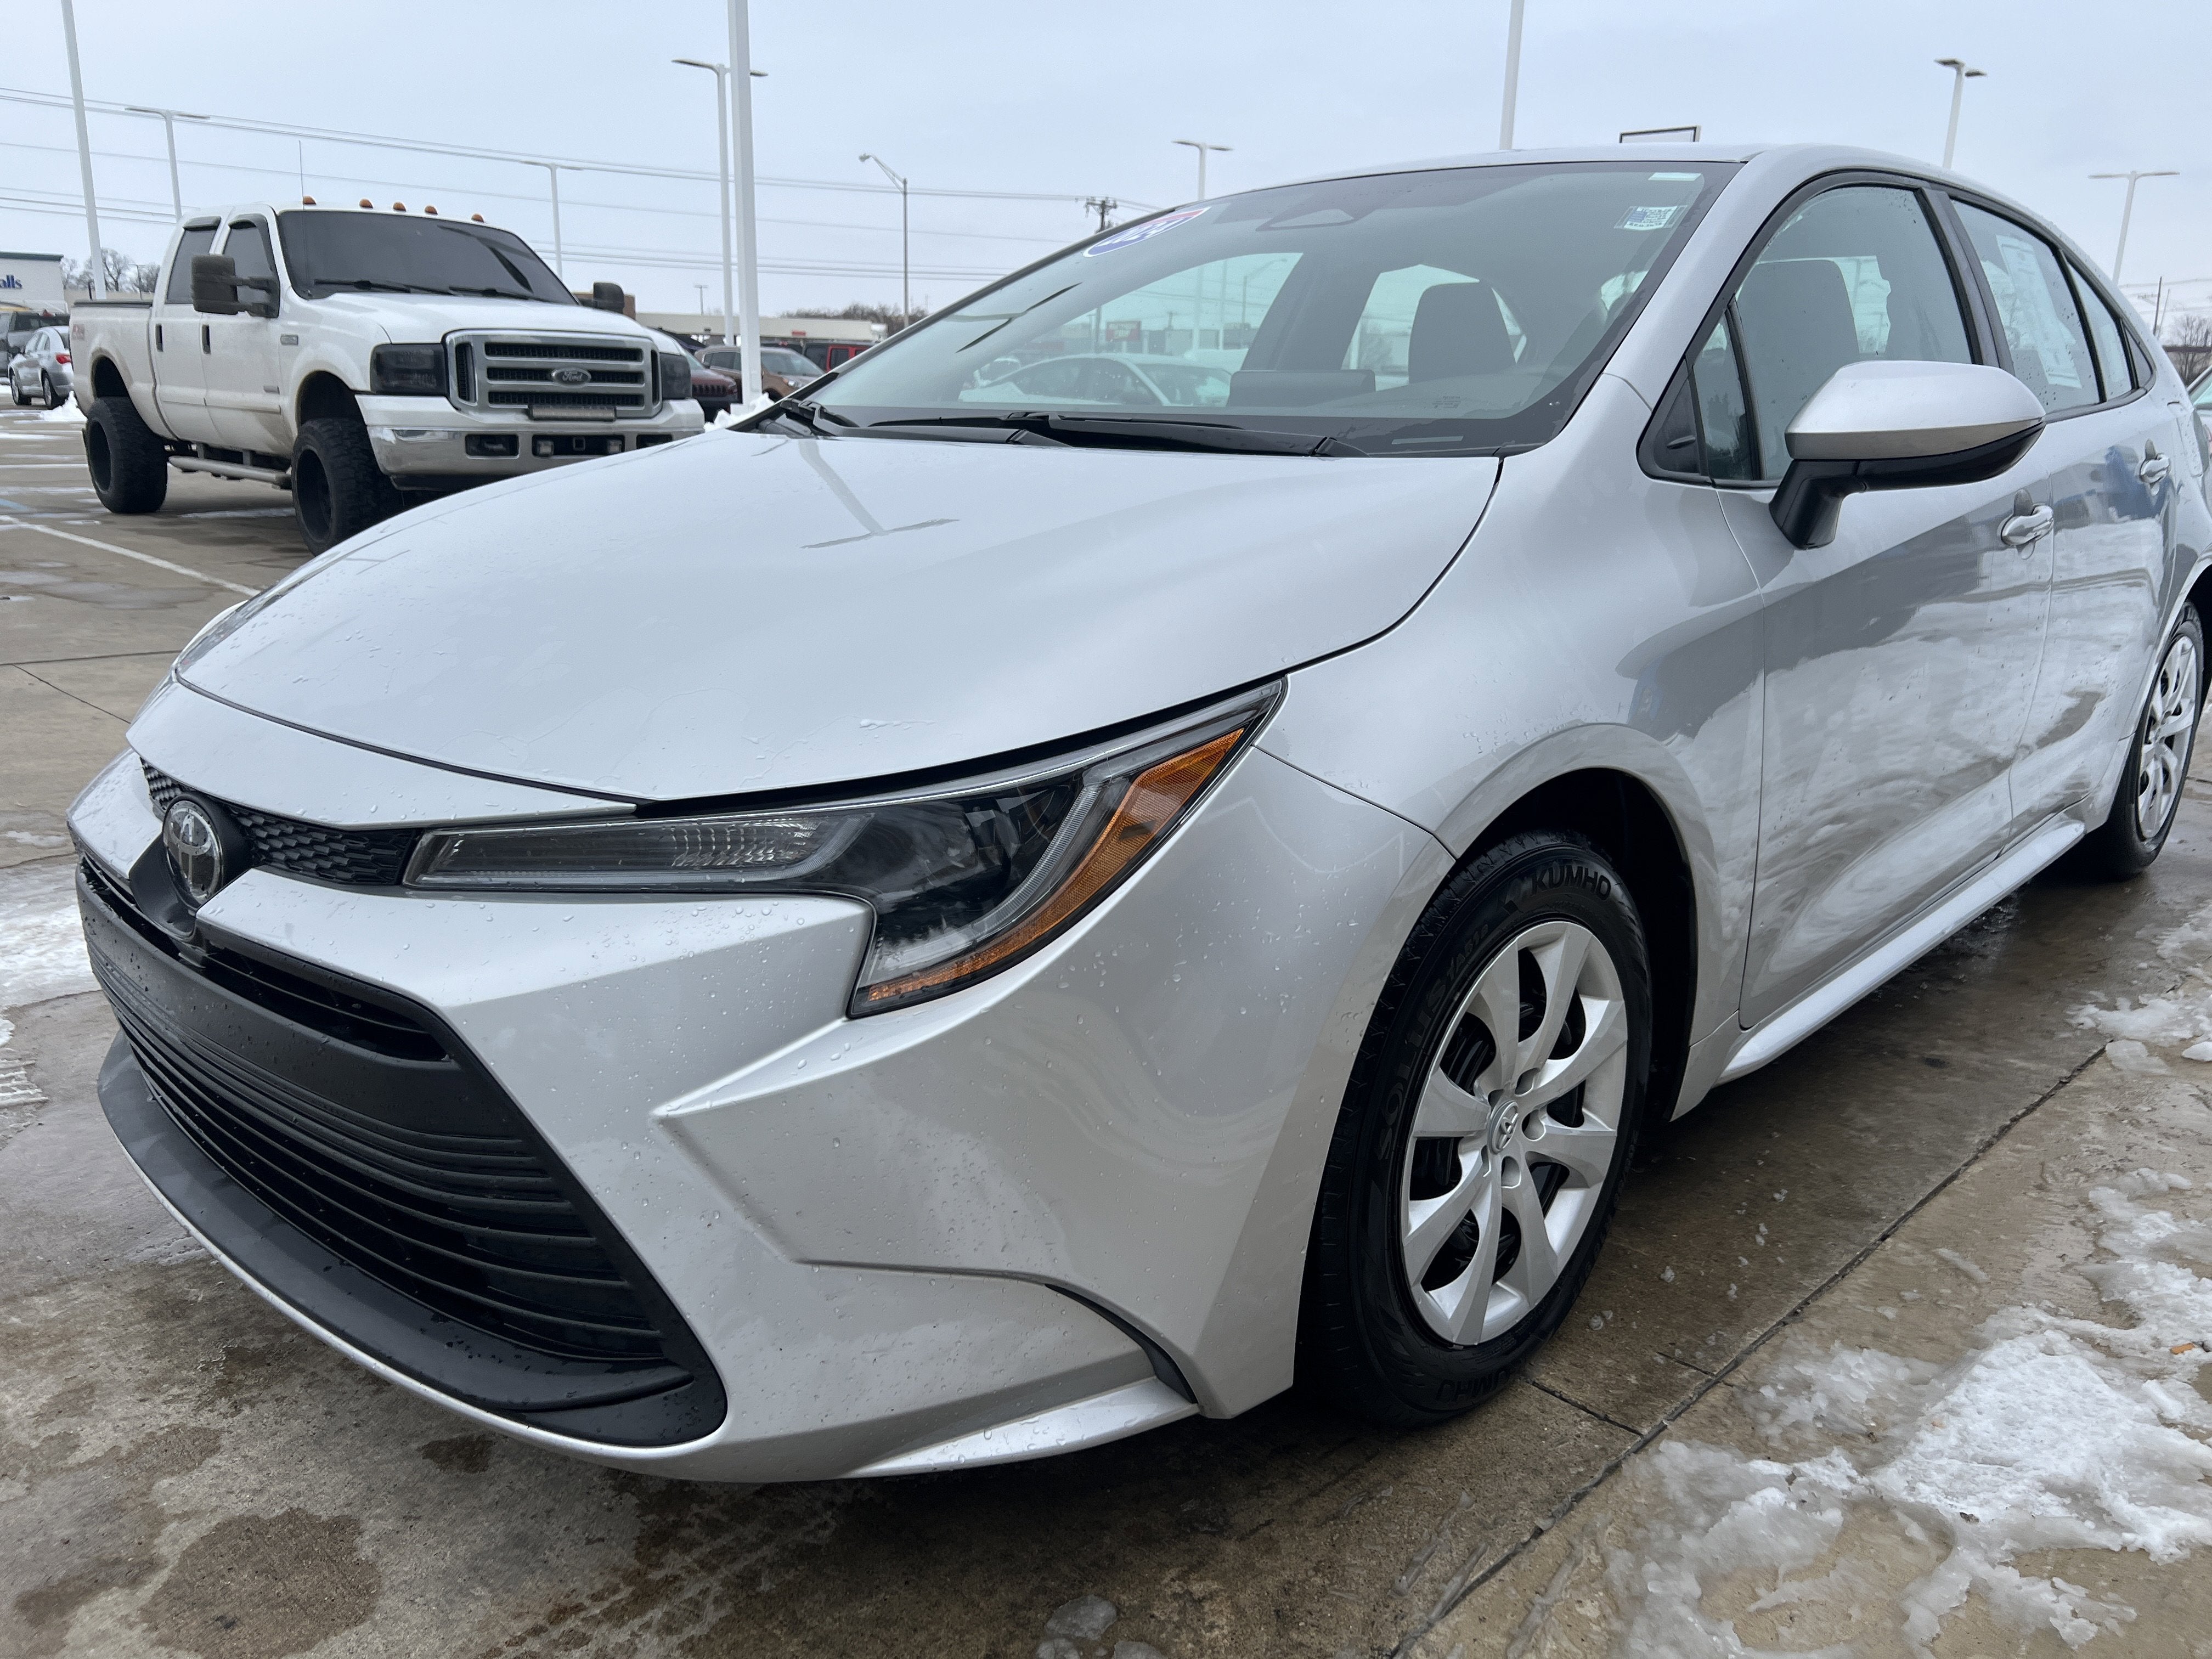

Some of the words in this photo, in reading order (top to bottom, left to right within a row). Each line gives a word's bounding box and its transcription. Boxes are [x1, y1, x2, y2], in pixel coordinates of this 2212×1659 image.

[1095, 218, 1184, 247] 2024
[562, 371, 583, 381] Ford
[1531, 865, 1611, 901] KUMHO
[1378, 978, 1446, 1160] SOLUS
